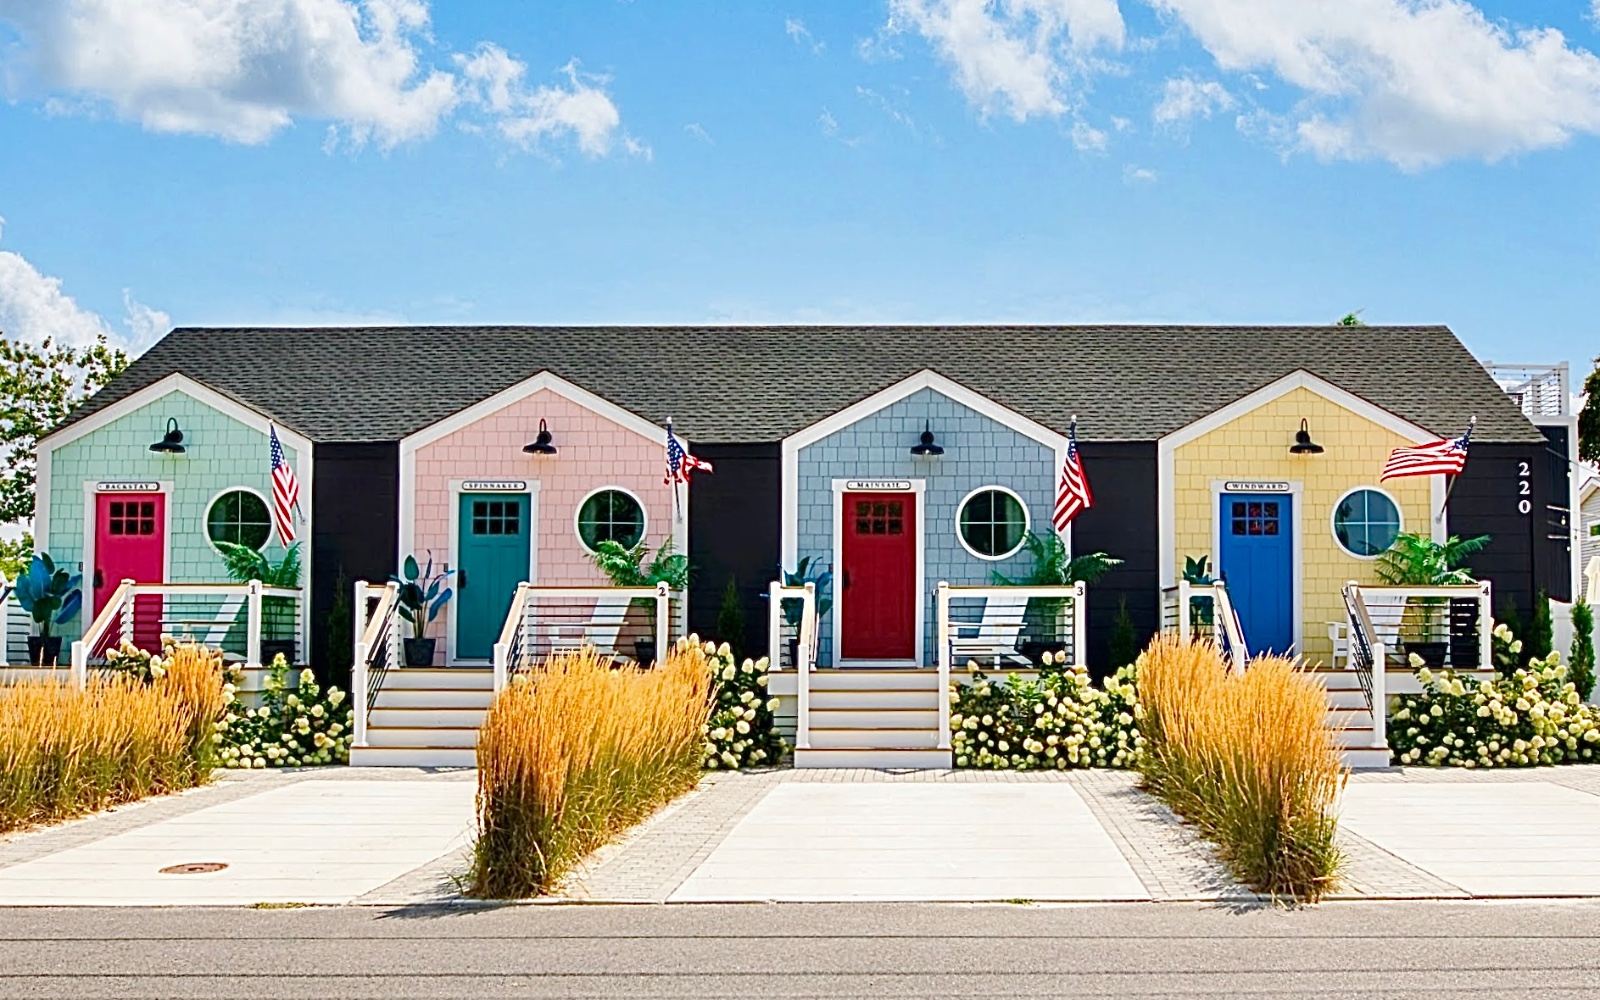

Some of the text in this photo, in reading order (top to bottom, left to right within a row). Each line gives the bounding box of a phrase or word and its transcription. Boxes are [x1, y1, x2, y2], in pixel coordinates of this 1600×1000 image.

[1518, 462, 1531, 514] 220
[250, 585, 256, 594] 1
[658, 587, 666, 596] 2
[1077, 586, 1084, 596] 3
[1482, 586, 1490, 596] 4
